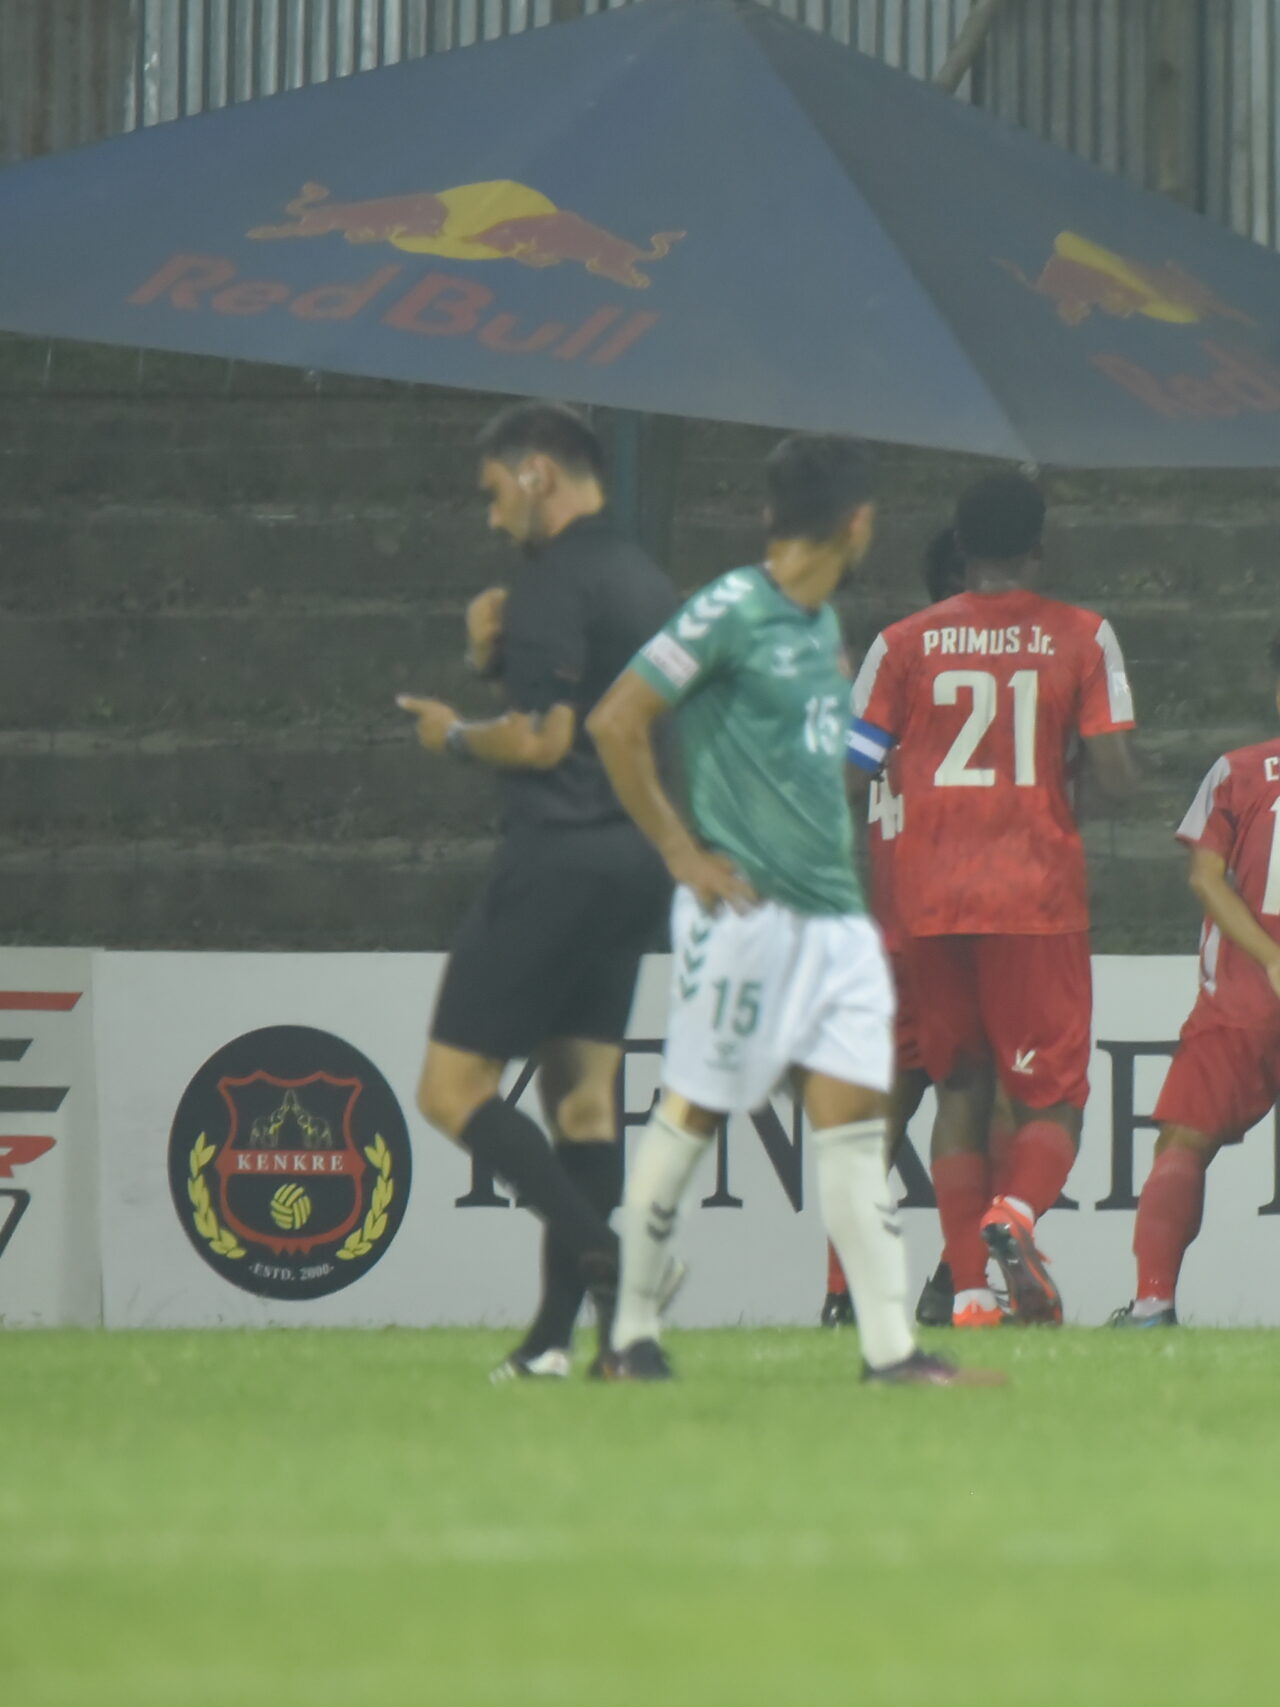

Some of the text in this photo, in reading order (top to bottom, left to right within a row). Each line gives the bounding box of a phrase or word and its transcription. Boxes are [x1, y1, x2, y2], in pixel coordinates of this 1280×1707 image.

[129, 252, 661, 366] Red Bull
[923, 625, 1055, 657] PRIMUS Jr.
[805, 696, 842, 755] 15
[933, 669, 1038, 787] 21
[712, 978, 763, 1037] 15
[237, 1153, 344, 1171] KENKRE
